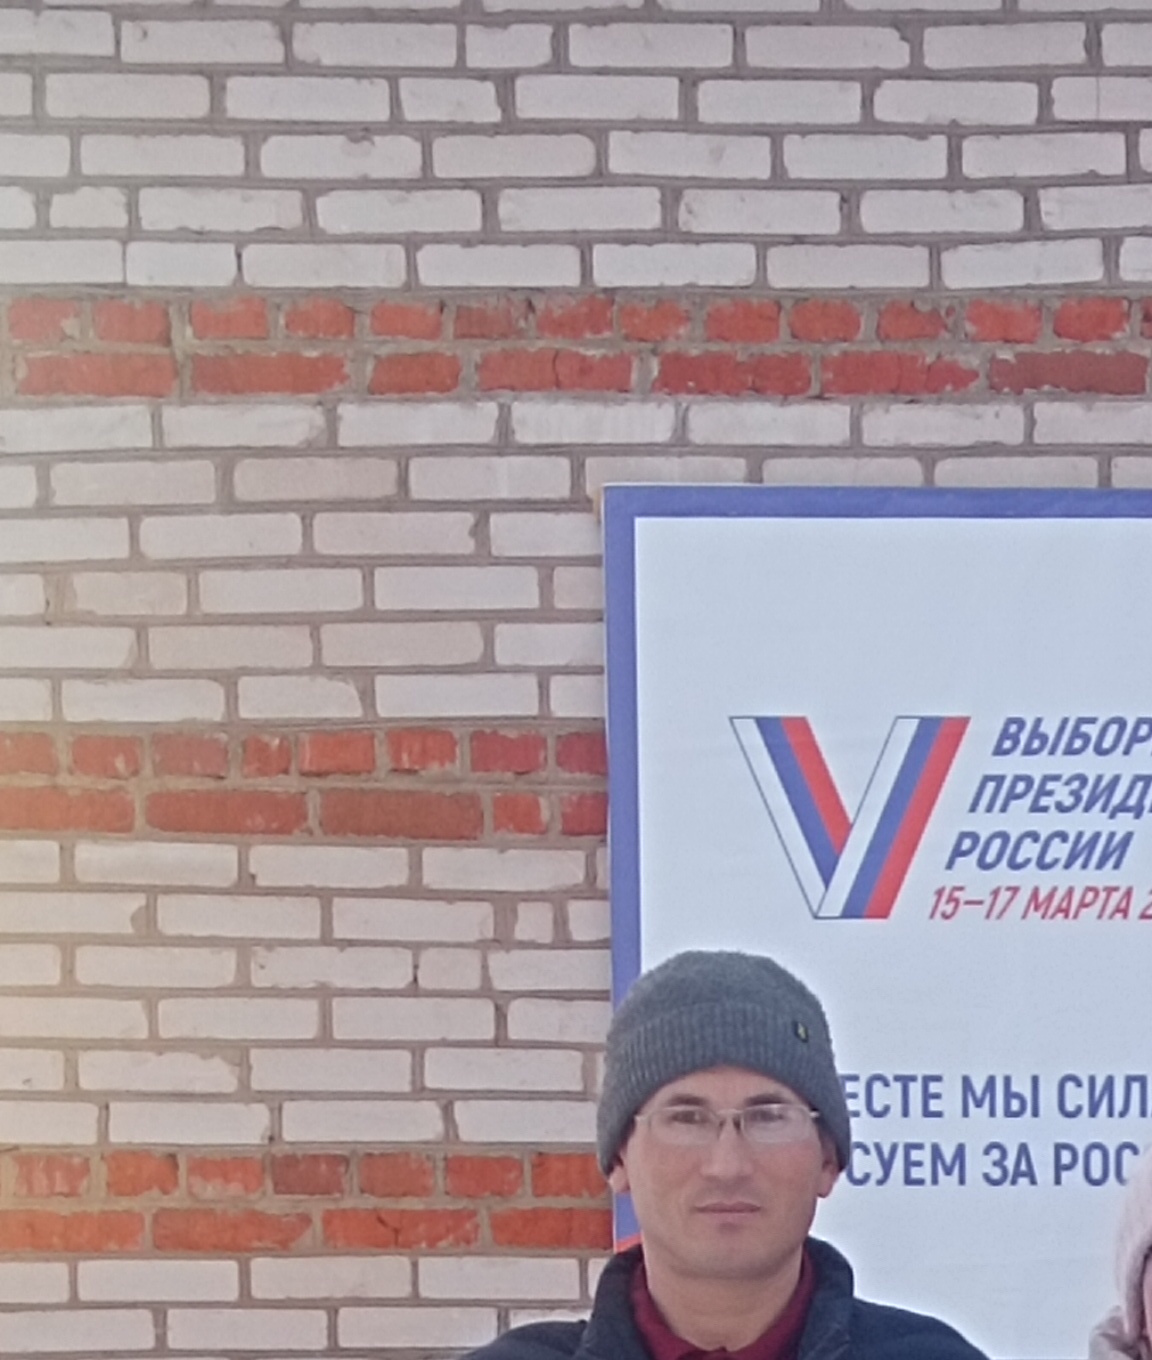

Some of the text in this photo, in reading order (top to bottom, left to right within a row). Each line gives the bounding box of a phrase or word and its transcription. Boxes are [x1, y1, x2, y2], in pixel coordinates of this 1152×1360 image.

[944, 830, 1135, 871] РОССИИ
[1021, 885, 1134, 920] МАРТА
[961, 1074, 1041, 1118] МЫ
[845, 1141, 967, 1187] СУЕМ
[982, 1141, 1038, 1187] ЗА
